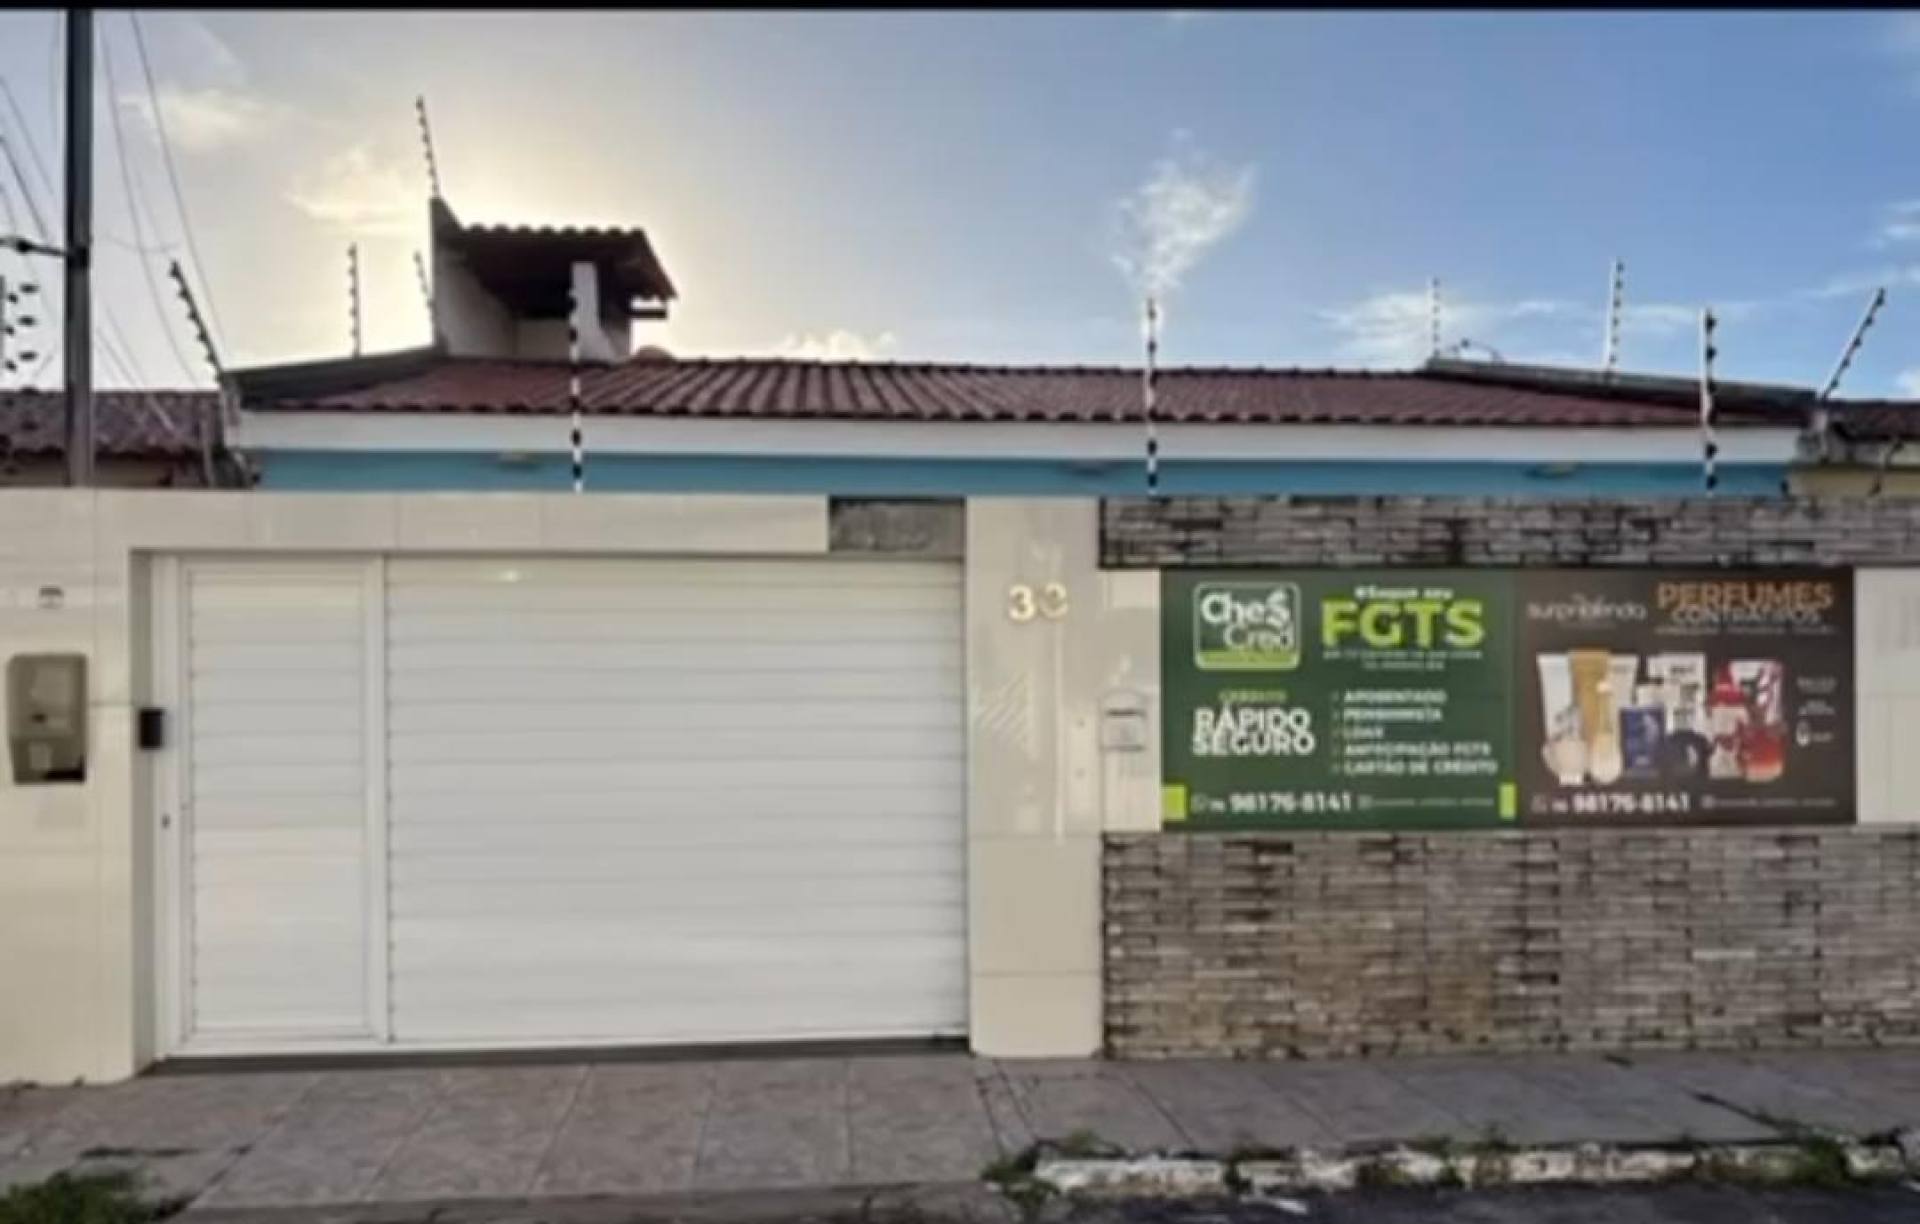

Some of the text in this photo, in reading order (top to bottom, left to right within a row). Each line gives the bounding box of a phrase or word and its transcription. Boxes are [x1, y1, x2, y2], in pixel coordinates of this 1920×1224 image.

[1009, 583, 1068, 621] 33
[1657, 582, 1833, 610] PERFUMES
[1322, 600, 1485, 647] FGTS
[1193, 702, 1311, 731] RÁPIDO
[1193, 730, 1315, 756] SEGURO
